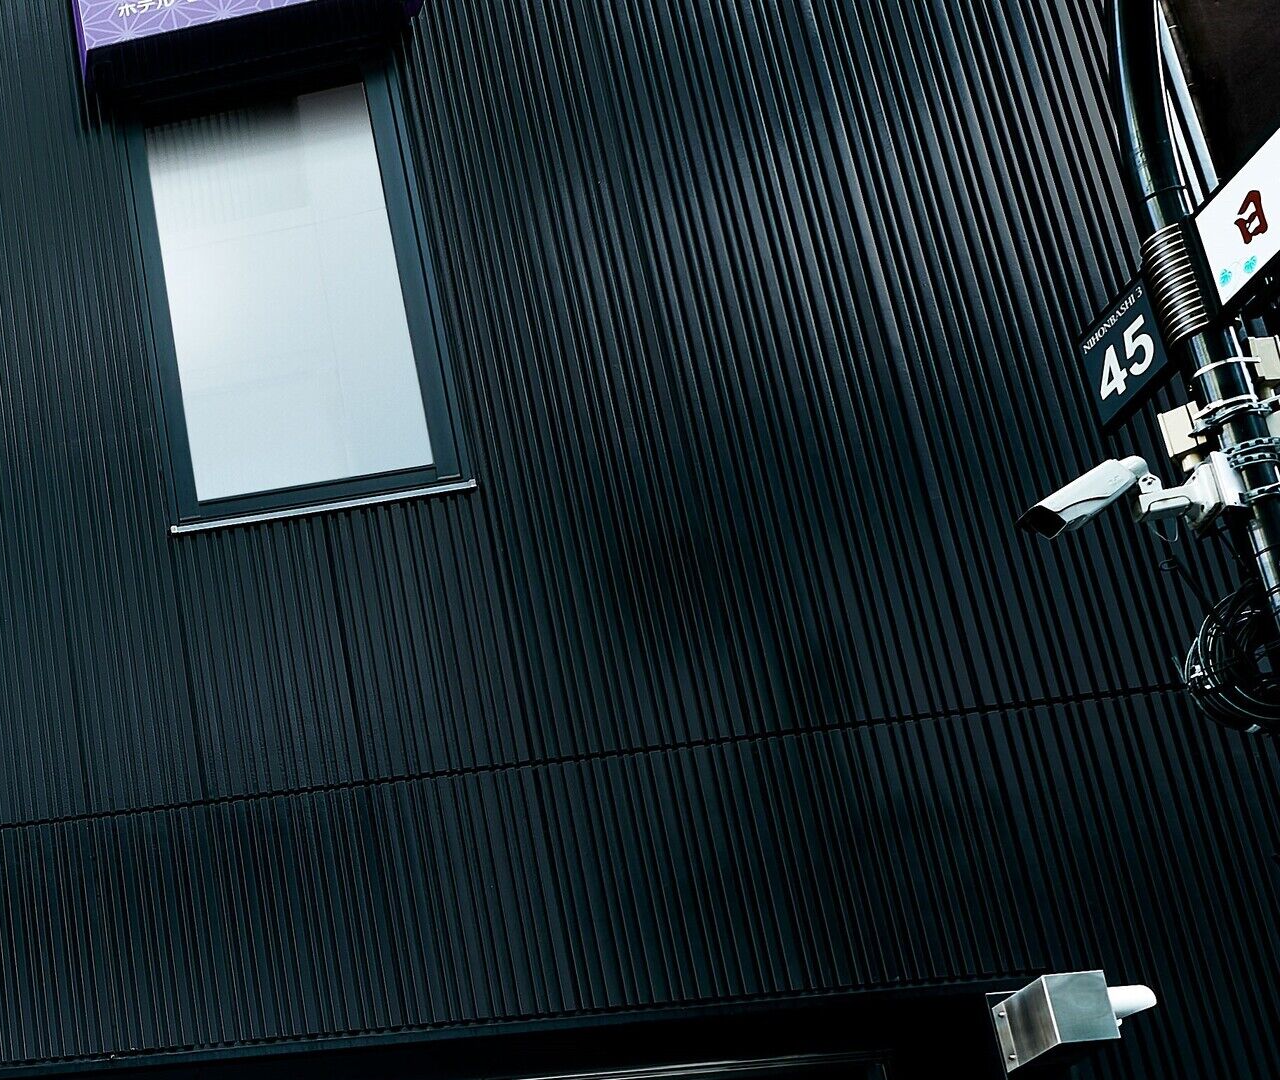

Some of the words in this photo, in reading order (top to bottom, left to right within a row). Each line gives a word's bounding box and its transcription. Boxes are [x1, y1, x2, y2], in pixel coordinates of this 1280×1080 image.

[1083, 293, 1136, 356] NIHONBASHI
[1134, 286, 1144, 300] 3
[1099, 313, 1155, 402] 45
